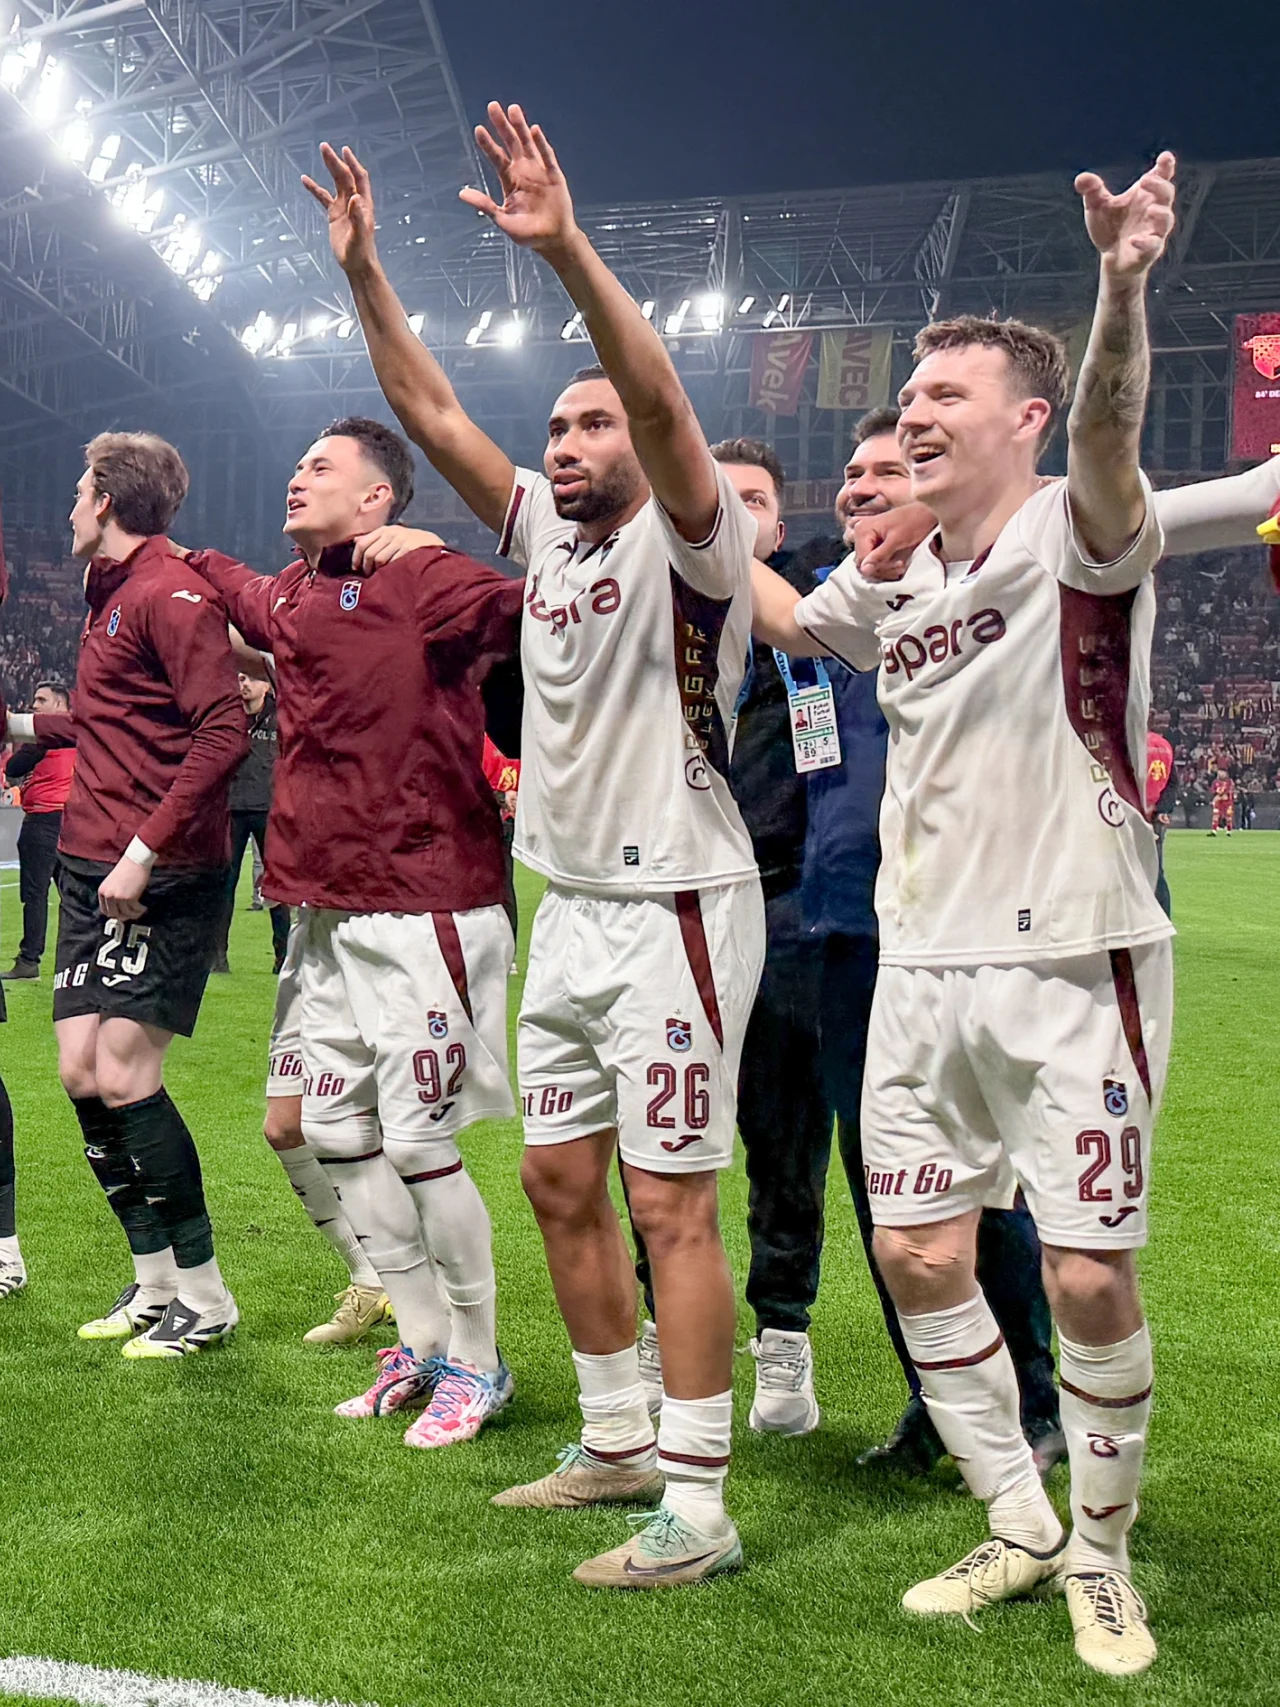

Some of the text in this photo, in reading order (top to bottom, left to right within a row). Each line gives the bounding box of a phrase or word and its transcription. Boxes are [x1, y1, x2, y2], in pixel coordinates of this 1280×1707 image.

[884, 608, 1006, 681] apara
[96, 918, 152, 976] 25
[317, 1073, 345, 1097] Go
[413, 1043, 467, 1104] 92
[540, 1087, 574, 1116] Go
[647, 1062, 710, 1129] 26
[913, 1163, 953, 1195] Go
[1076, 1126, 1144, 1202] 29
